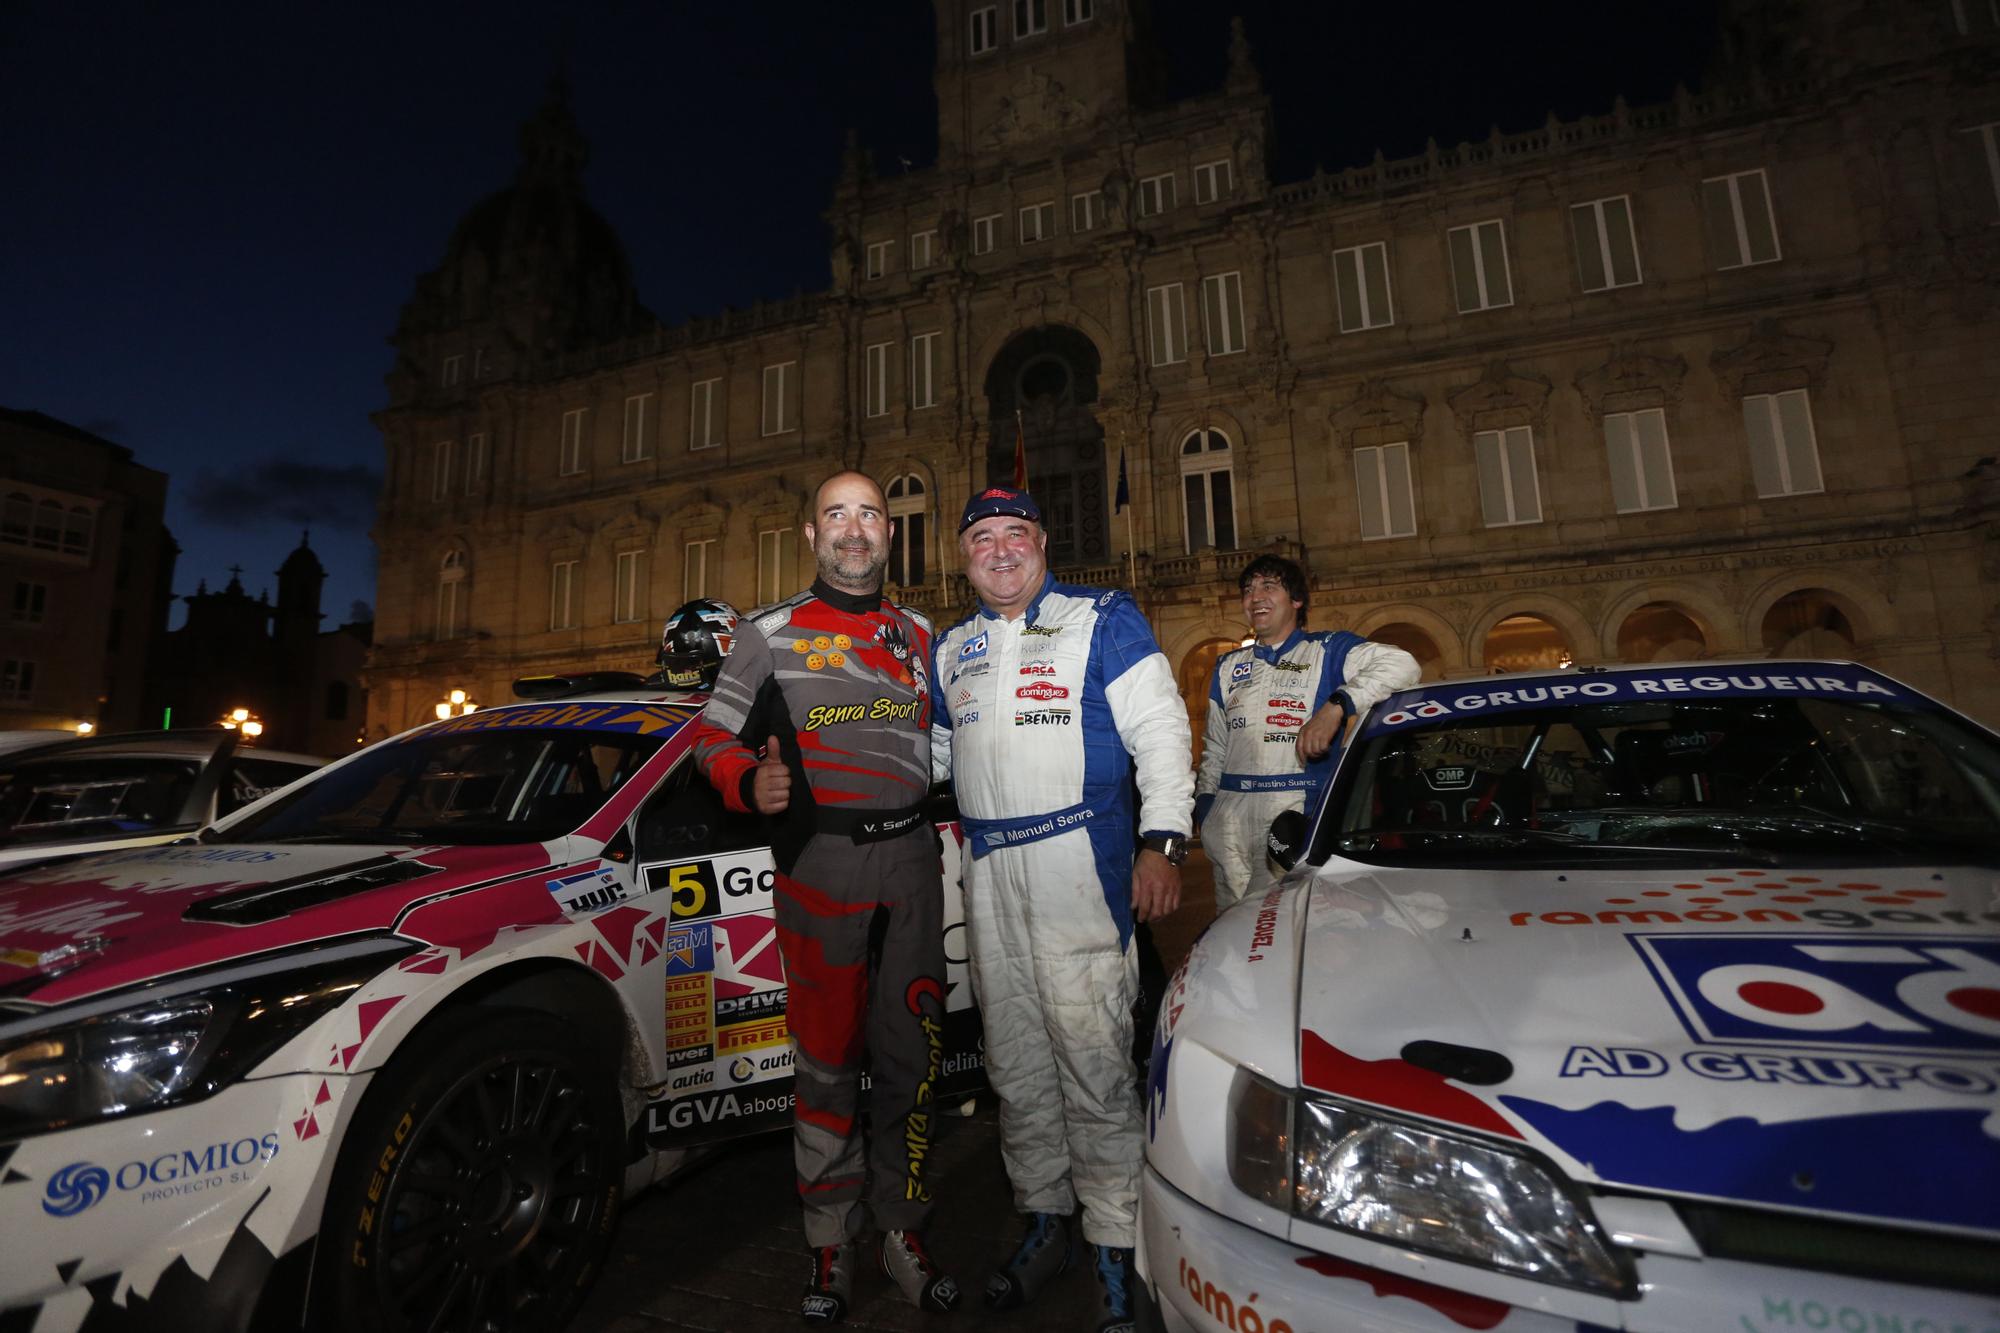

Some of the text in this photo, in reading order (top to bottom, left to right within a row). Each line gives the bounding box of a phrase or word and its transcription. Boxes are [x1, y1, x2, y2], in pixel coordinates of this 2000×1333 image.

[1454, 682, 1618, 710] GRUPO
[1633, 674, 1897, 698] REGUEIRA
[804, 698, 919, 732] Senra Sport
[1024, 714, 1072, 726] BENITO
[1436, 770, 1465, 781] OMP
[864, 812, 921, 833] V. Senra
[1007, 807, 1095, 842] Manuel Senra
[669, 864, 707, 917] 5
[673, 1069, 714, 1090] autia
[1559, 1046, 1996, 1096] AD GRUPO
[115, 1132, 280, 1191] OGMIOS
[142, 1171, 254, 1204] PROYECTO S.L.
